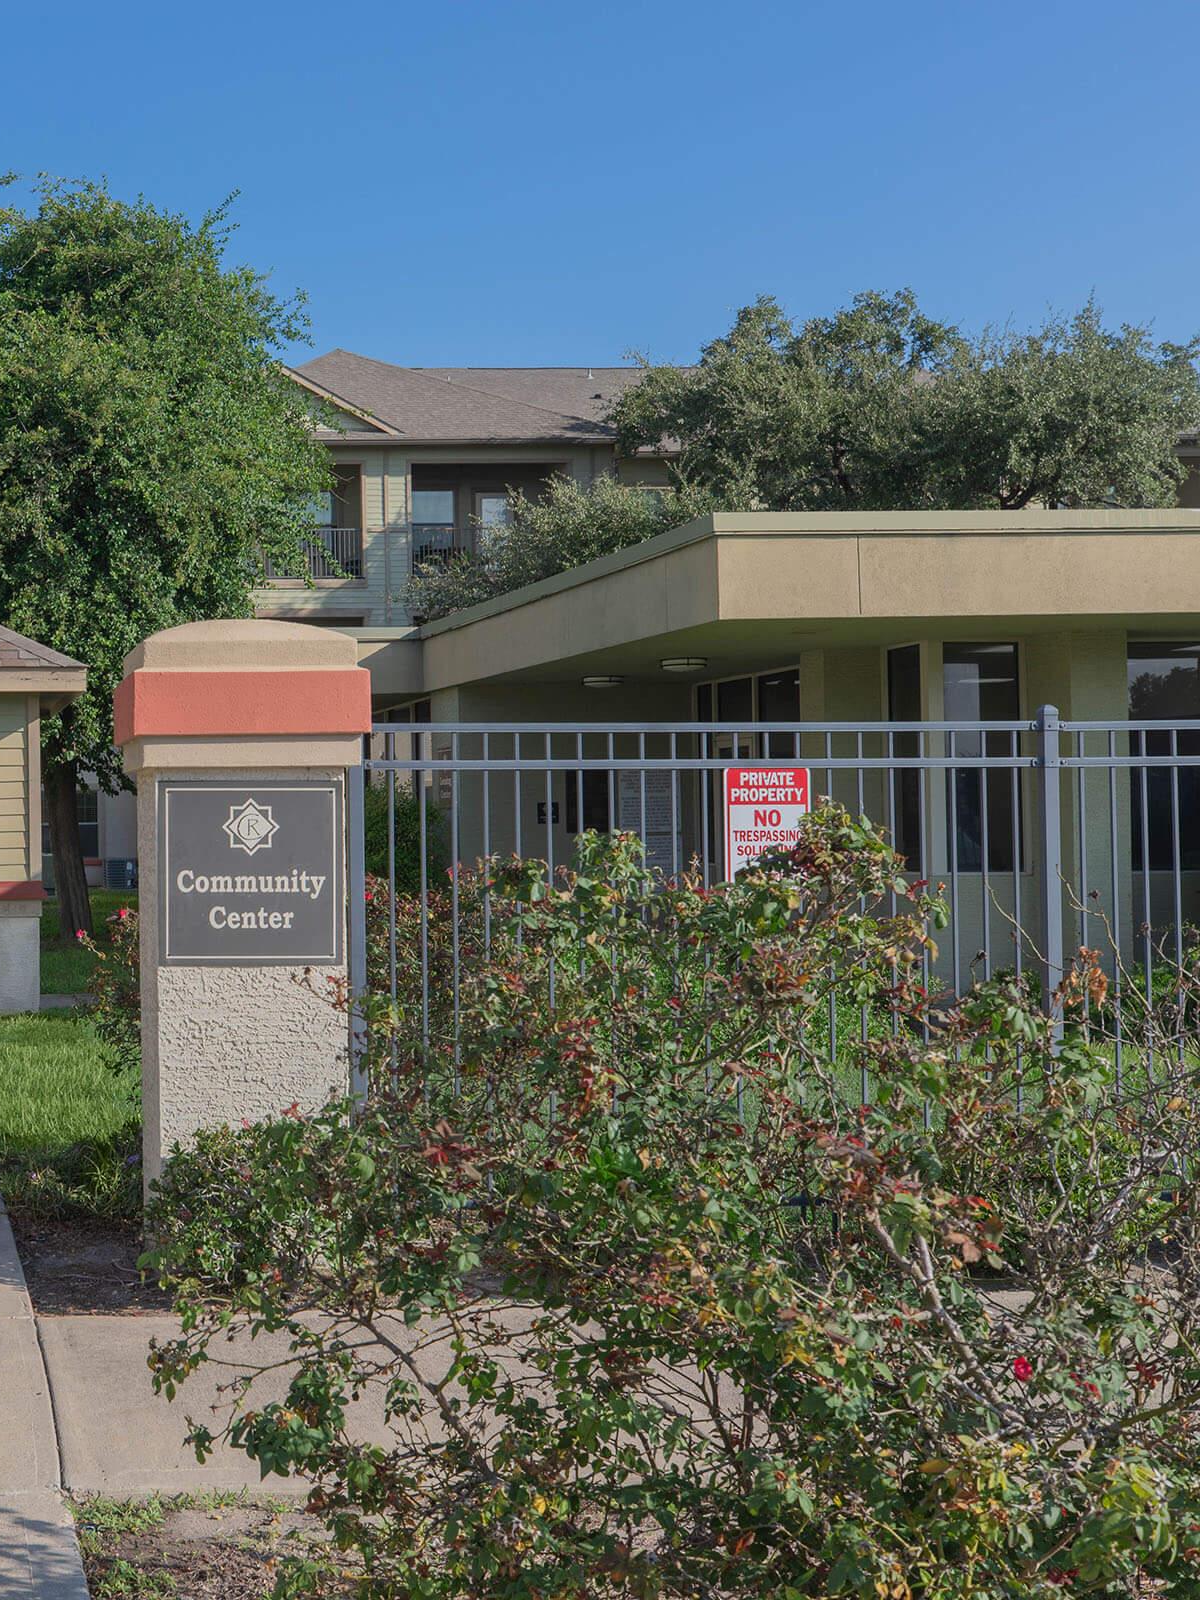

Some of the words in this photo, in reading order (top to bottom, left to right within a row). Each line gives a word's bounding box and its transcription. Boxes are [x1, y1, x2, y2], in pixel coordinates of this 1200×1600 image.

[740, 772, 795, 786] PRIVATE
[731, 788, 804, 802] PROPERTY
[753, 809, 782, 827] NO
[176, 869, 326, 899] Community
[208, 906, 294, 929] Center
